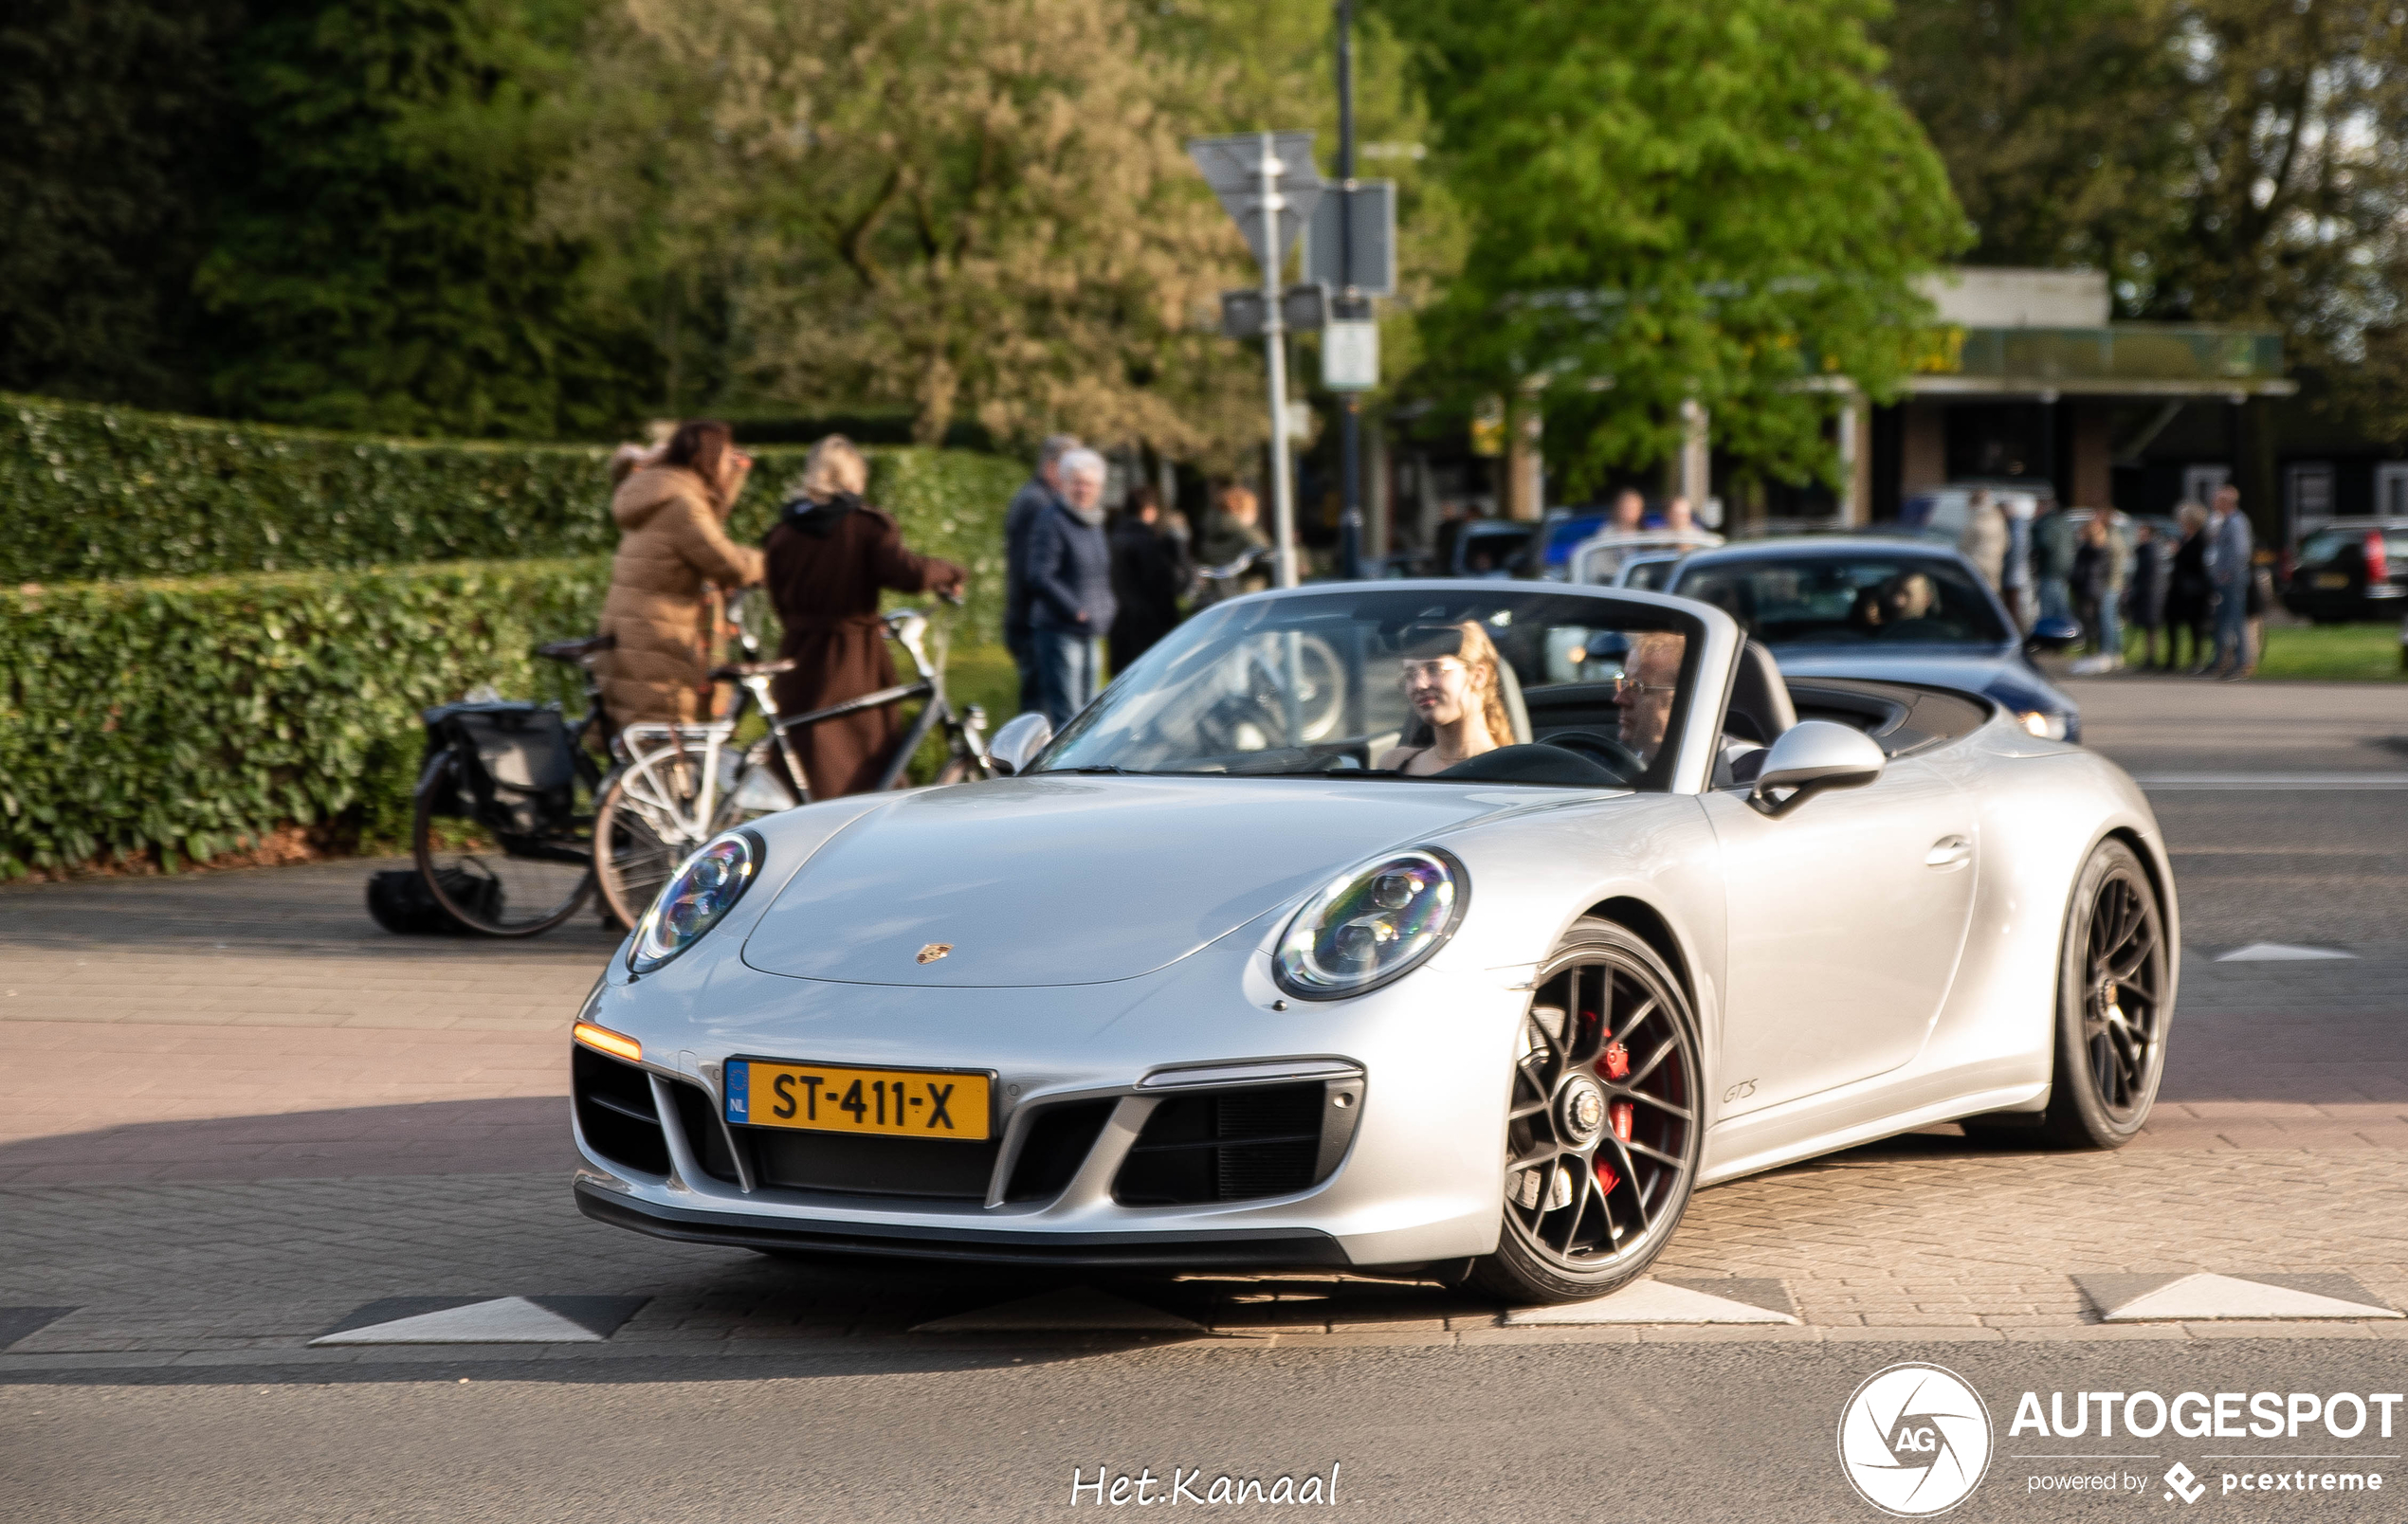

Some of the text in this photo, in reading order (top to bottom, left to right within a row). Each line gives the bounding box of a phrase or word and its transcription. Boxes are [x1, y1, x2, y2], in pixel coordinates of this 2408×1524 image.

[773, 1073, 955, 1130] ST-411-X
[1723, 1078, 1759, 1104] GTS
[729, 1098, 747, 1113] NL
